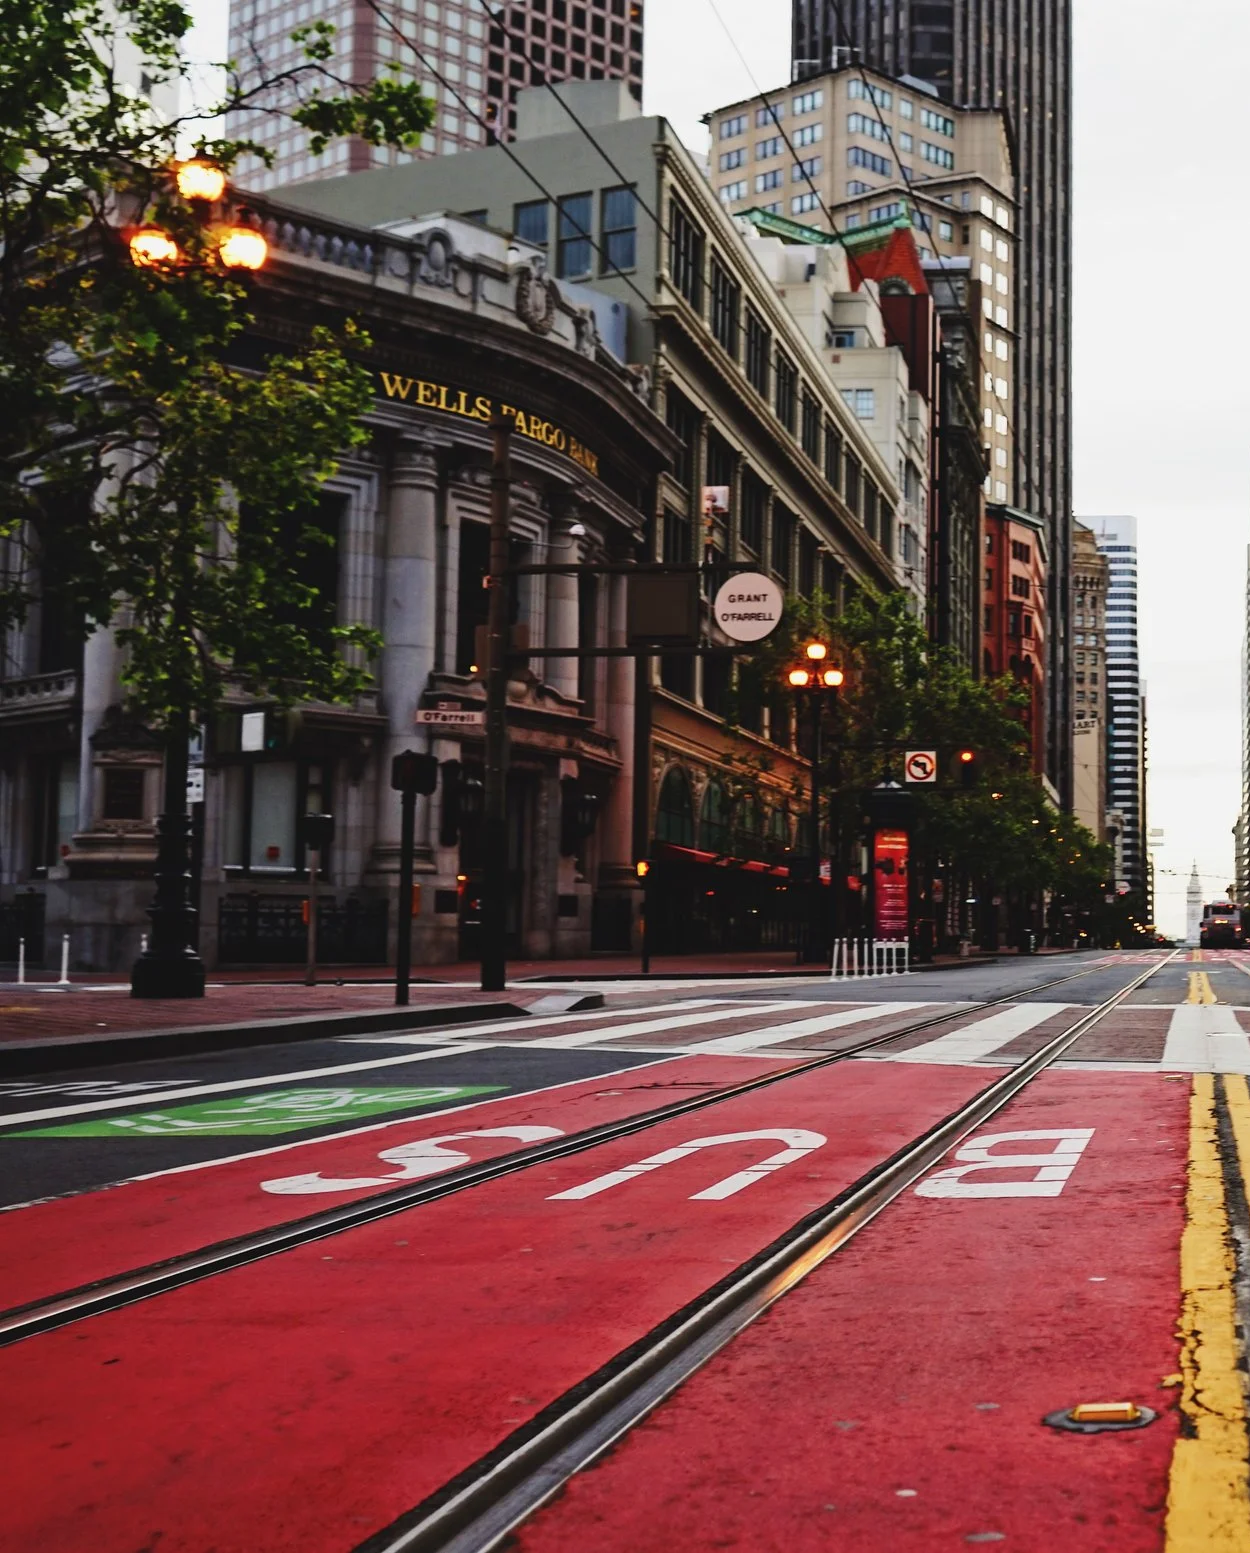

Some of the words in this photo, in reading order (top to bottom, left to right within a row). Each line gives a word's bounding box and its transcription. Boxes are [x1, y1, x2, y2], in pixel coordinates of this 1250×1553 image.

[380, 371, 492, 422] WELLS
[728, 593, 768, 603] GRANT
[721, 612, 775, 622] O'FARRELL
[423, 711, 476, 722] O'Farrell
[260, 1123, 1096, 1201] BUS
